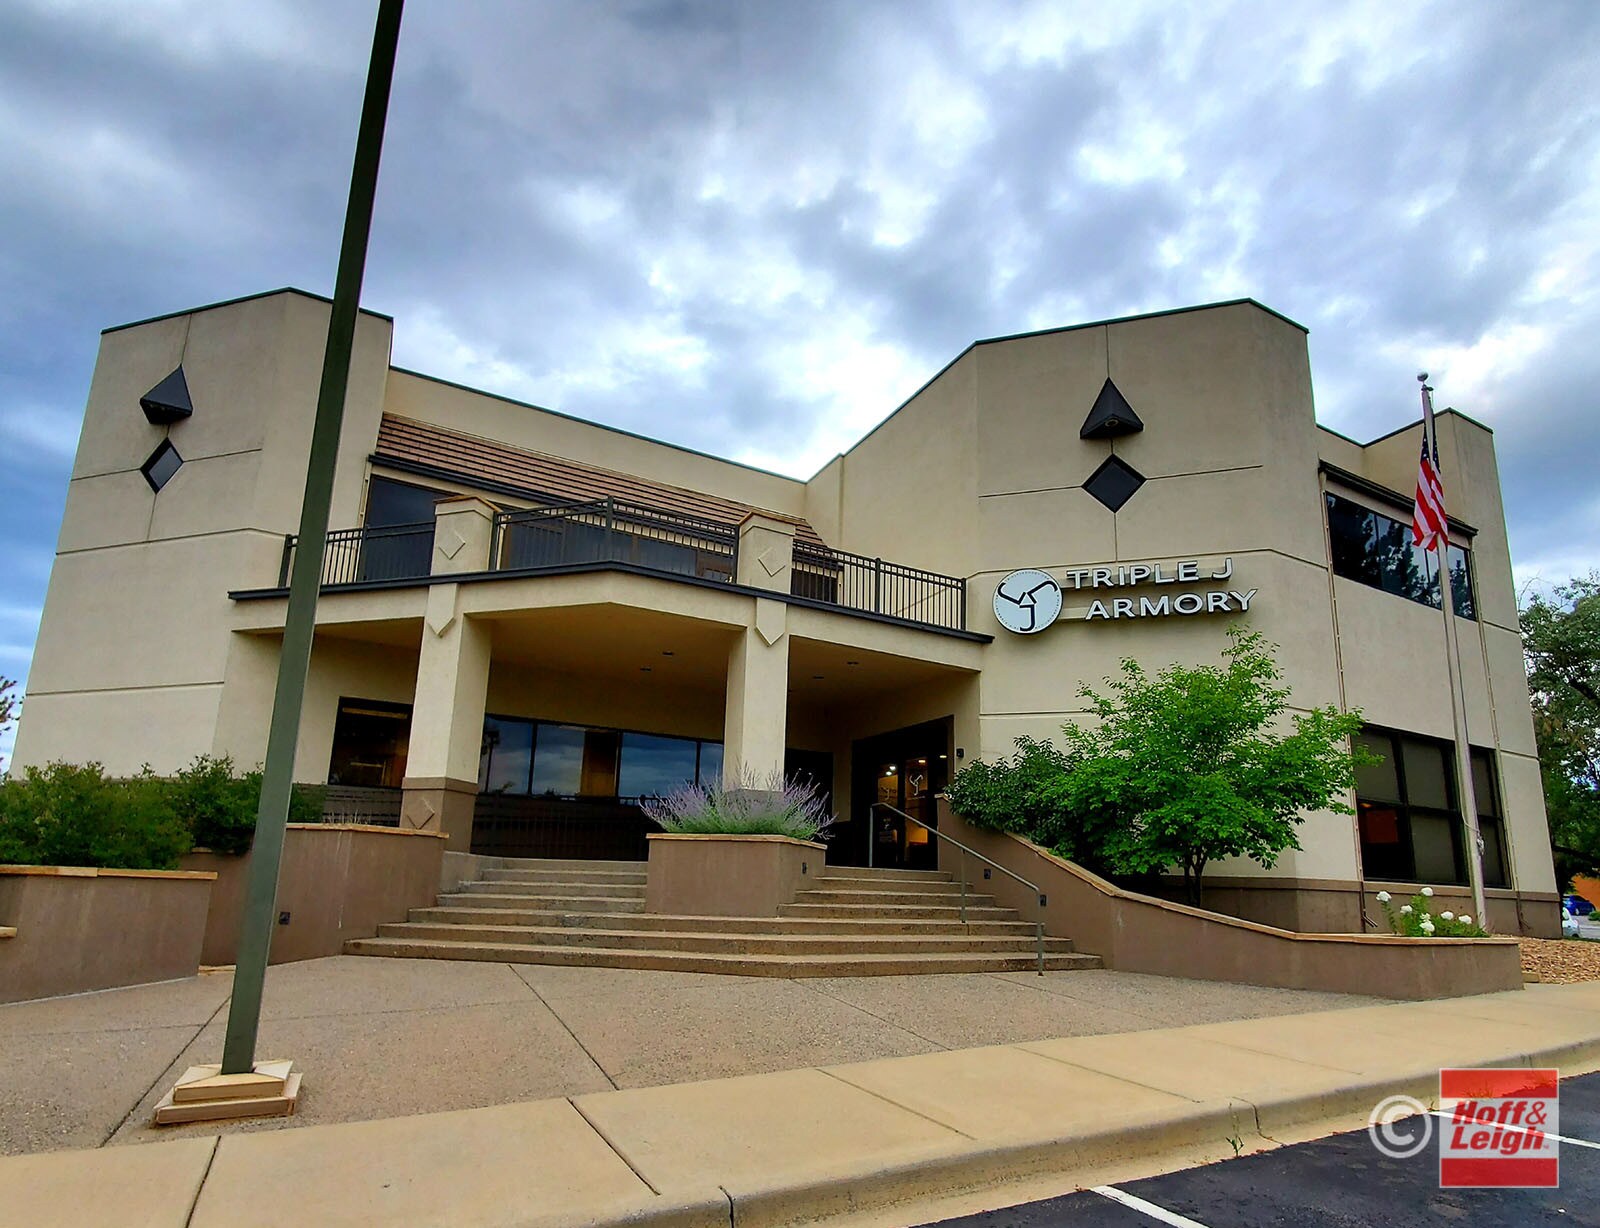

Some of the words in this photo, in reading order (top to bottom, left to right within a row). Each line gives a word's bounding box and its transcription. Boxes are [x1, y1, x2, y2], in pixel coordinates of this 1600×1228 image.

[1066, 561, 1200, 589] TRIPLE
[1212, 557, 1234, 582] J
[1085, 588, 1258, 621] ARMORY
